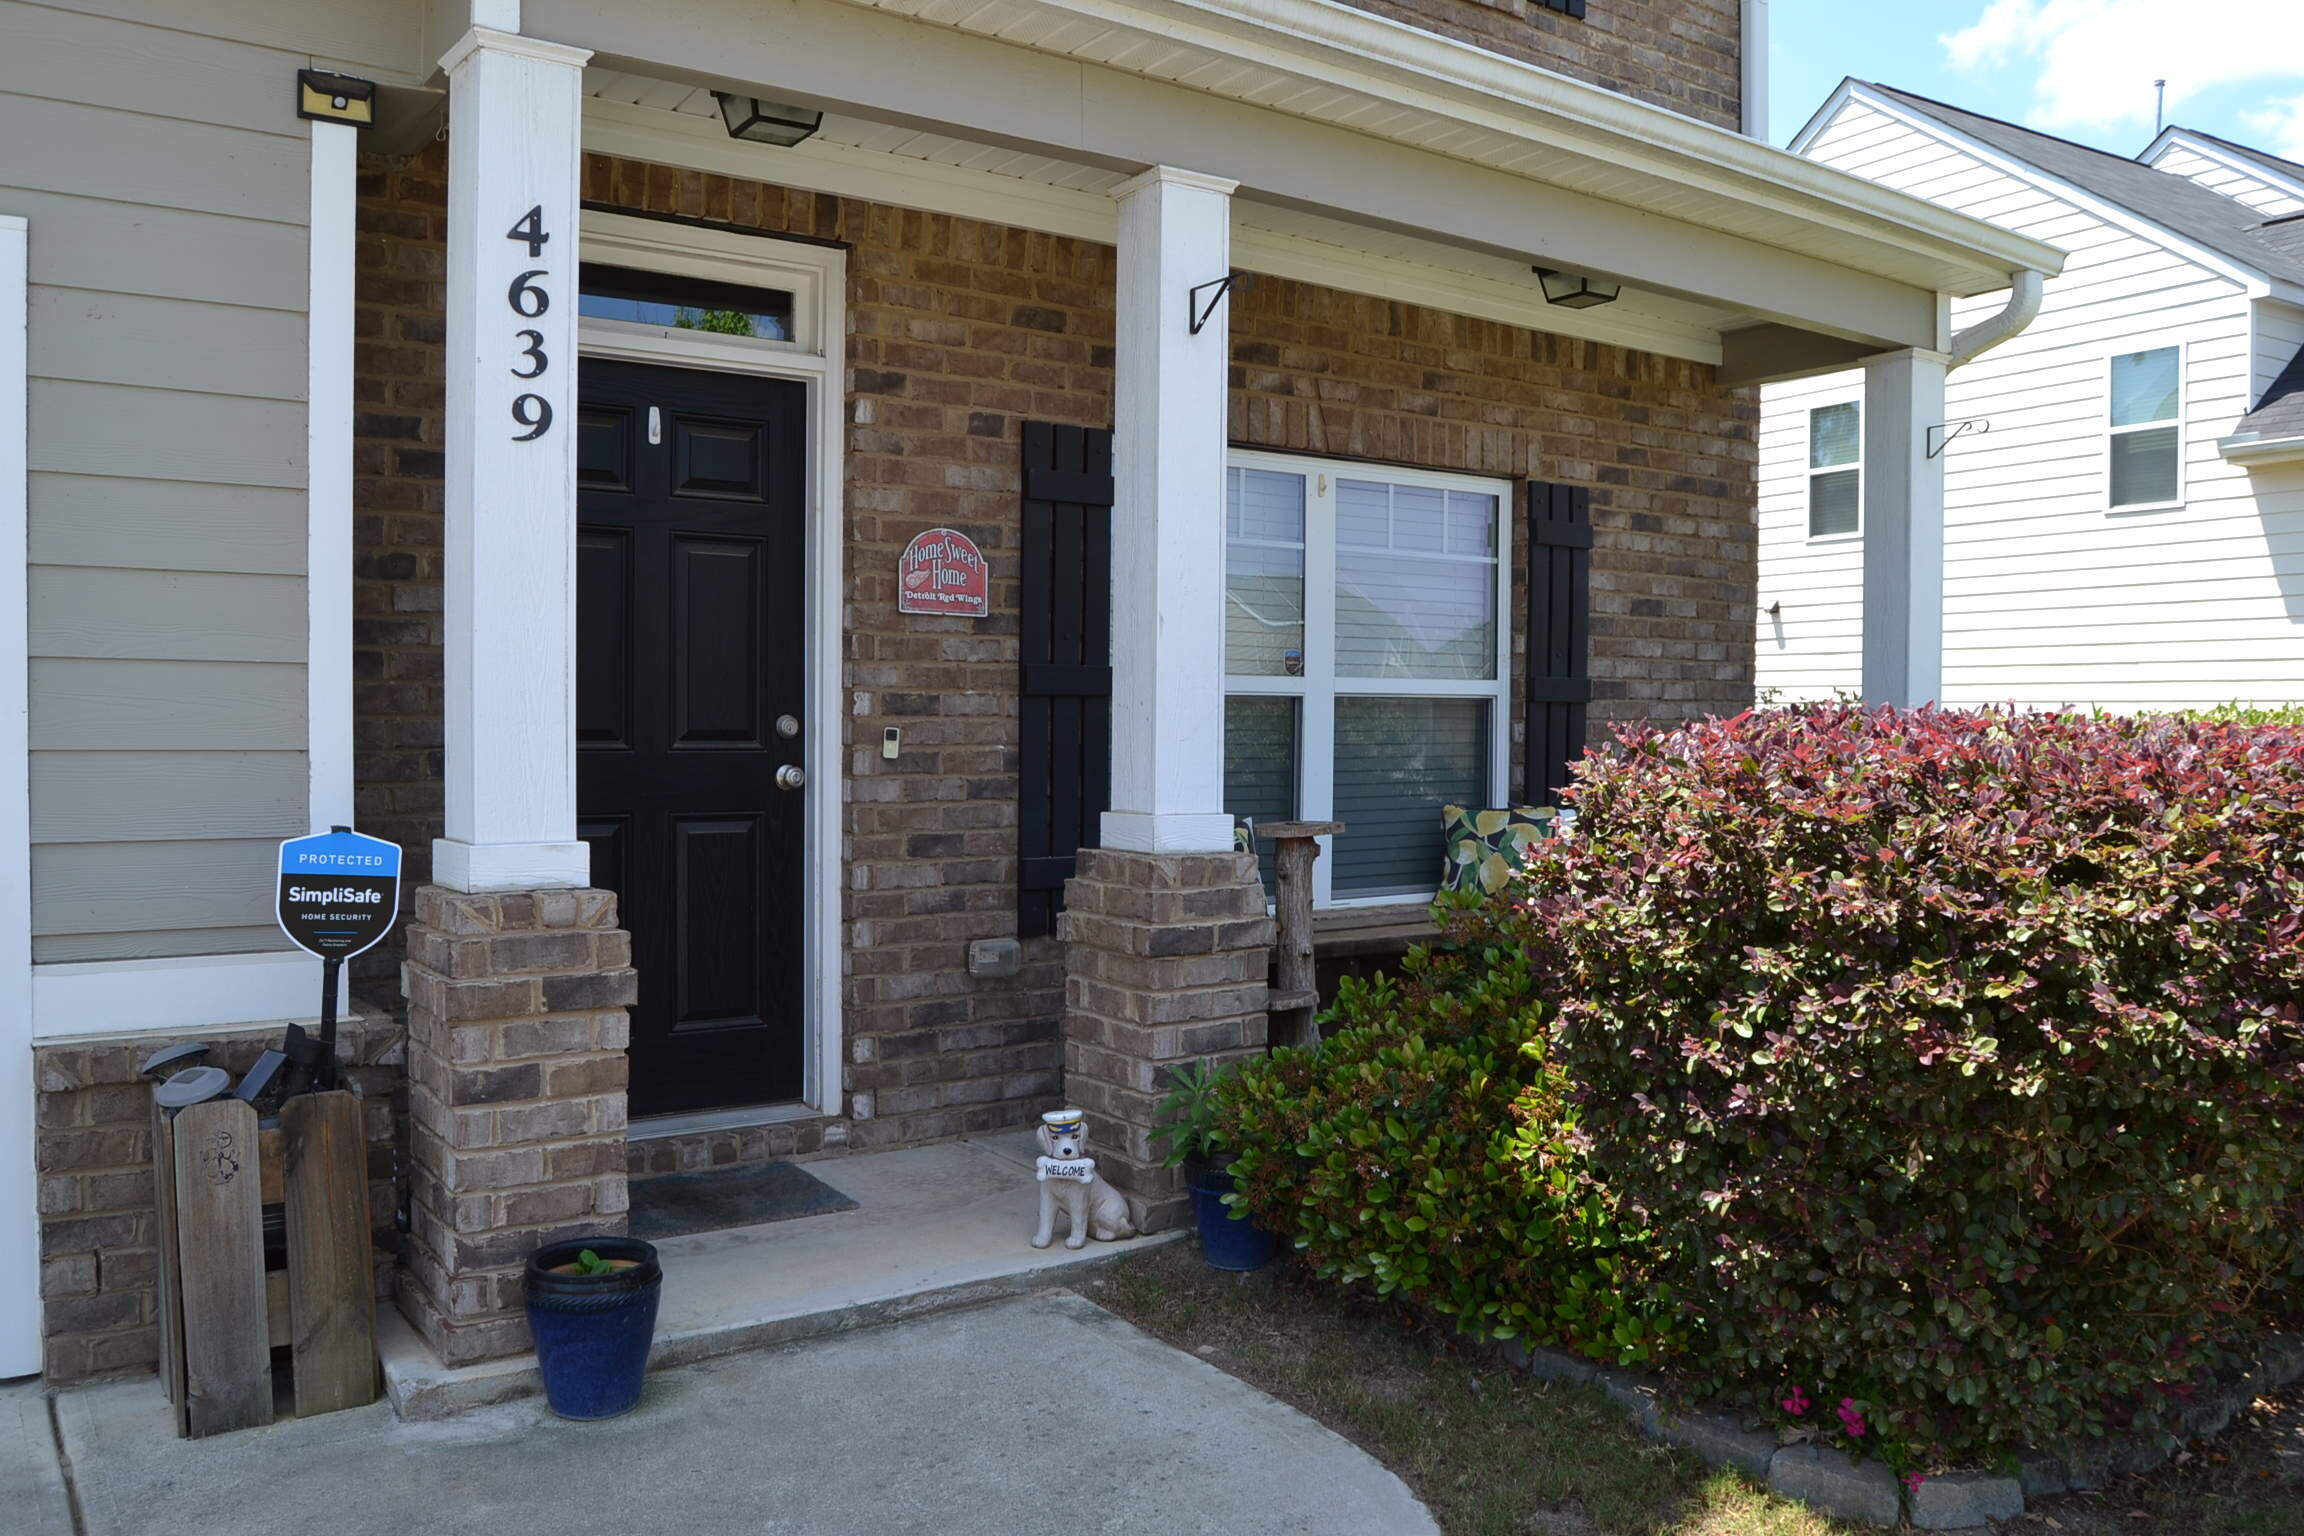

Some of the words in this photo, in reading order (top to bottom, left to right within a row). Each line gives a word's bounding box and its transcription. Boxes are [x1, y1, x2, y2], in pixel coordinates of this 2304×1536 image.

[506, 204, 553, 442] 4639
[910, 543, 944, 571] Home
[945, 537, 979, 574] Sweet
[932, 559, 967, 590] Home
[905, 591, 936, 600] Detroit
[938, 592, 954, 603] Red
[956, 594, 982, 604] Wings
[299, 854, 383, 866] PROTECTED
[289, 887, 382, 905] SimpliSafe
[301, 913, 326, 921] HOME
[330, 913, 372, 921] SECURITY
[1045, 1165, 1086, 1177] WELCOME
